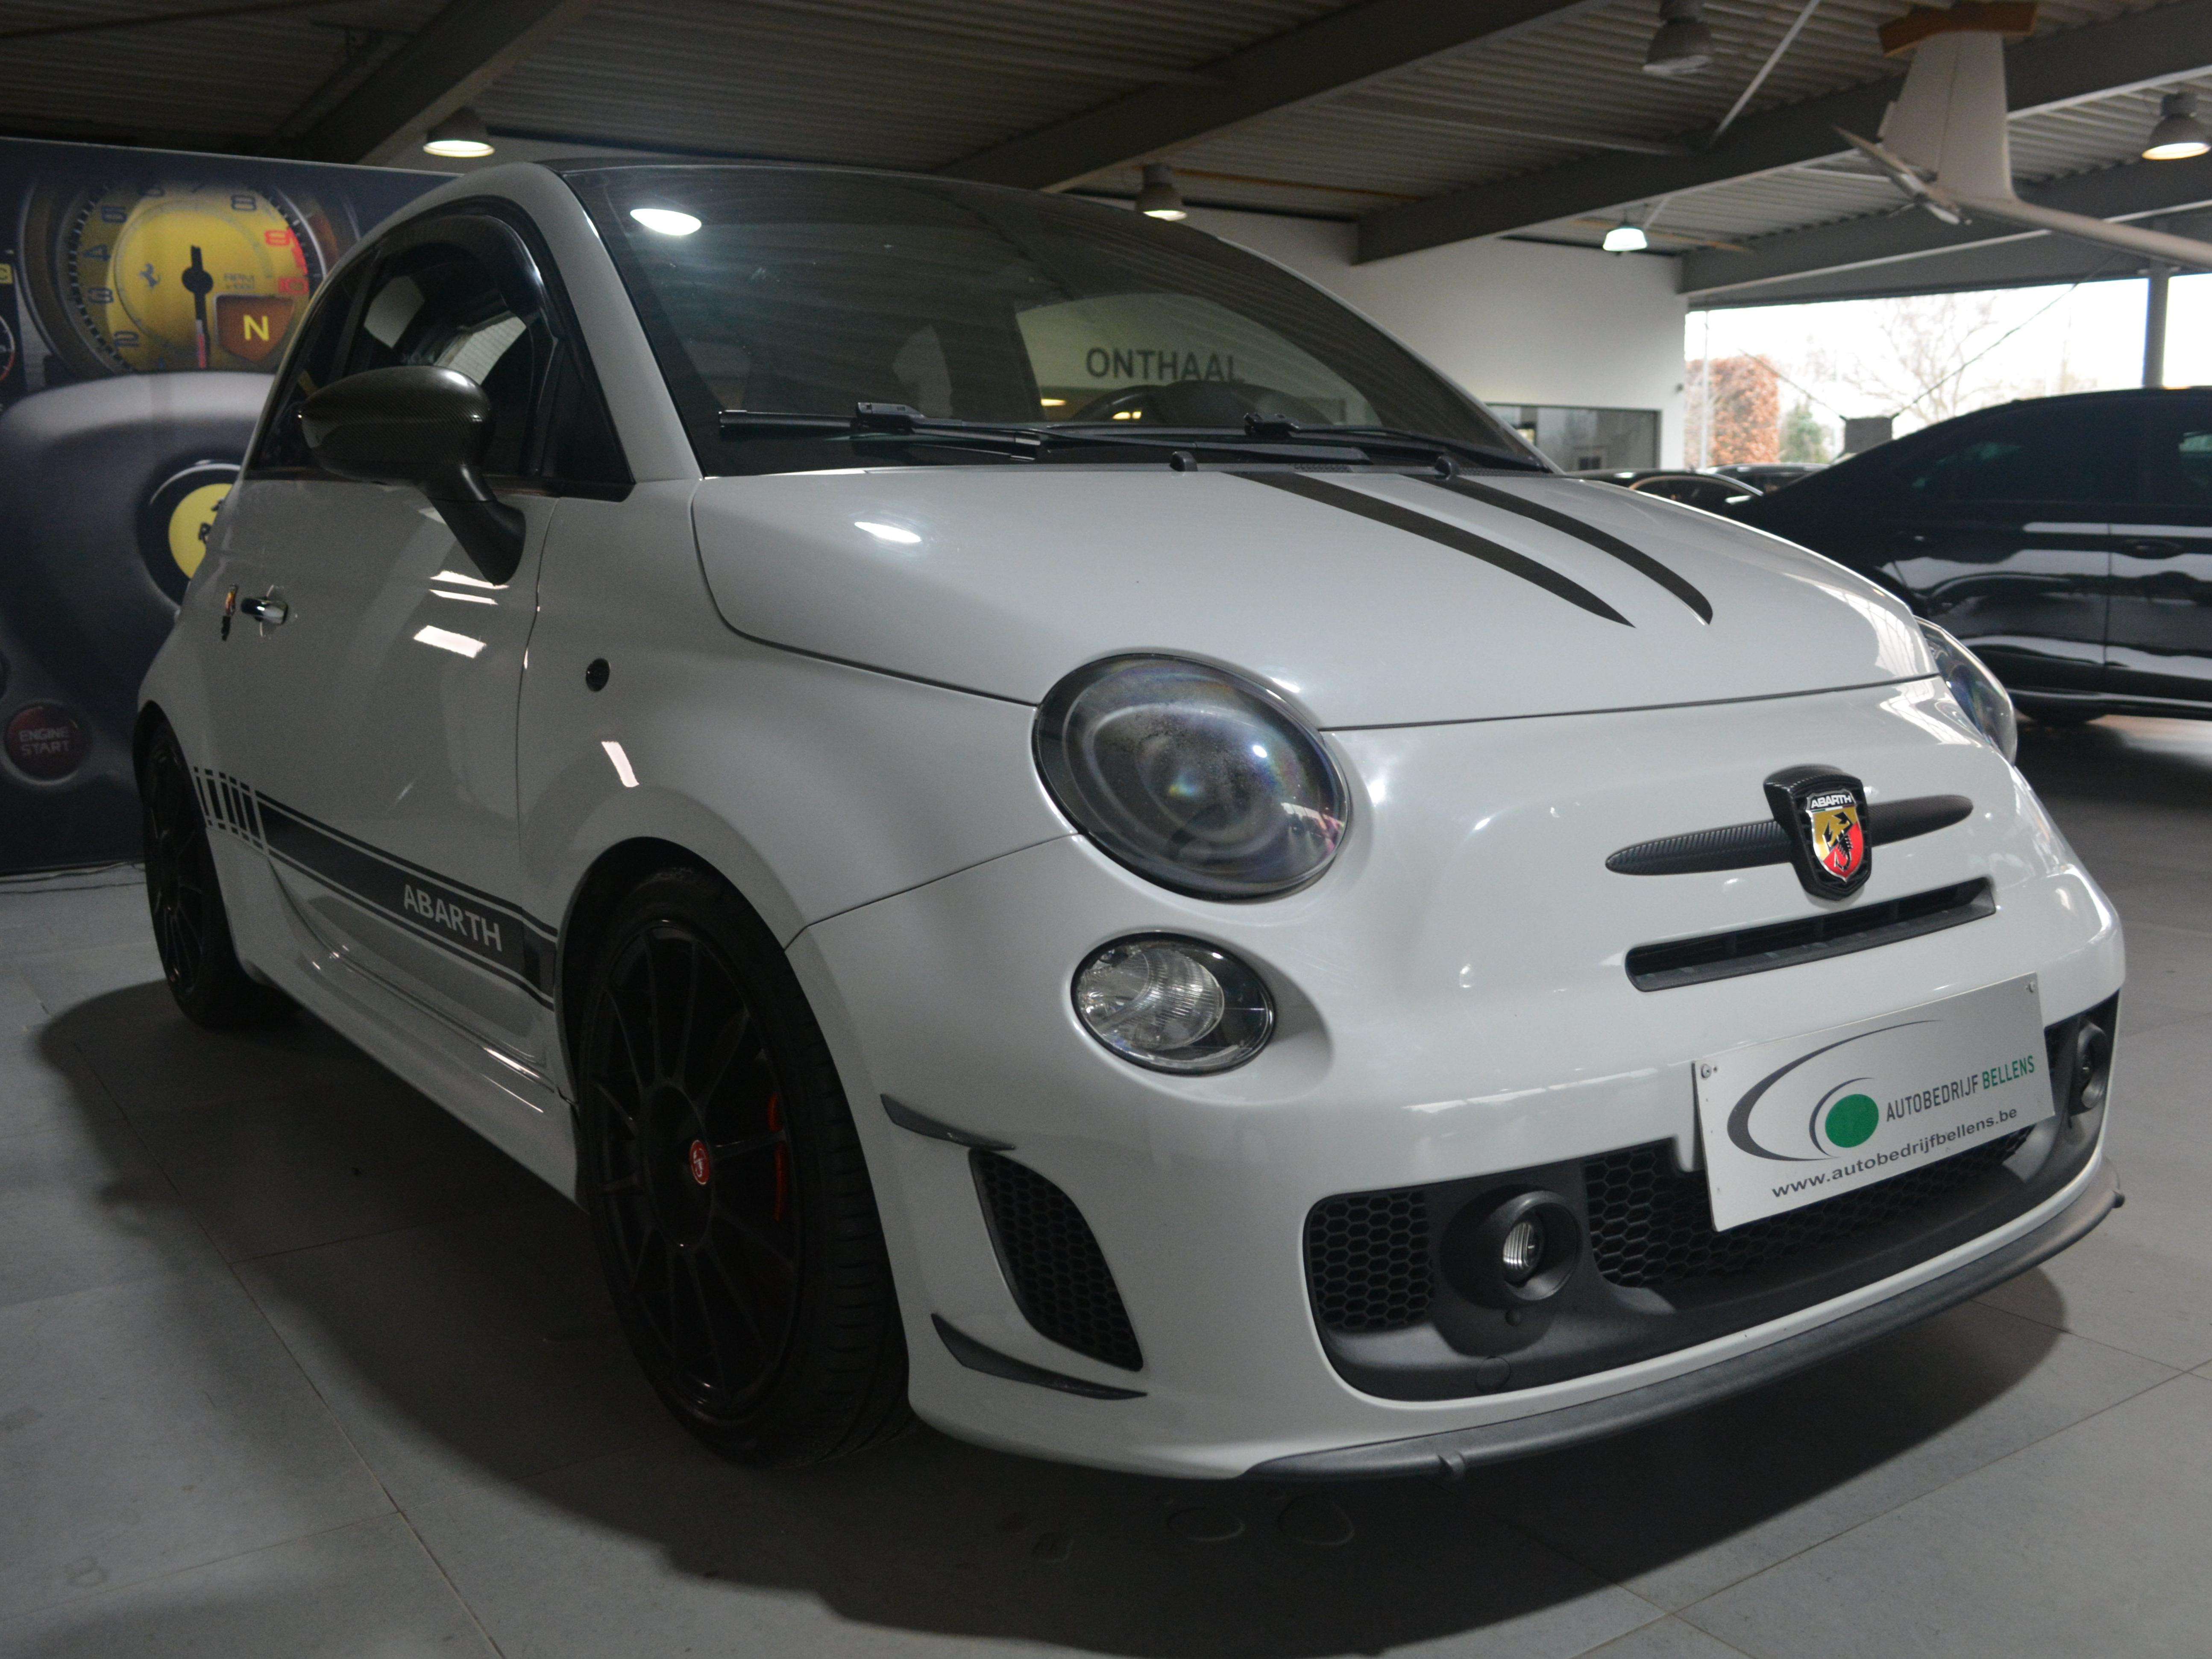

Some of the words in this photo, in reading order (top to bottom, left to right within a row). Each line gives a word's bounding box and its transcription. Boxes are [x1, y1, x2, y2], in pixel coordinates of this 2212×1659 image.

[243, 314, 269, 341] N
[19, 727, 69, 741] ENGINE
[21, 741, 69, 756] START
[1810, 794, 1852, 809] ABARTH
[403, 884, 502, 952] ABARTH
[1886, 1074, 1978, 1122] AUTOBEDRIJF
[1982, 1055, 2035, 1090] BELLENS
[1772, 1108, 2017, 1197] www.autobedrijfbellens.be
